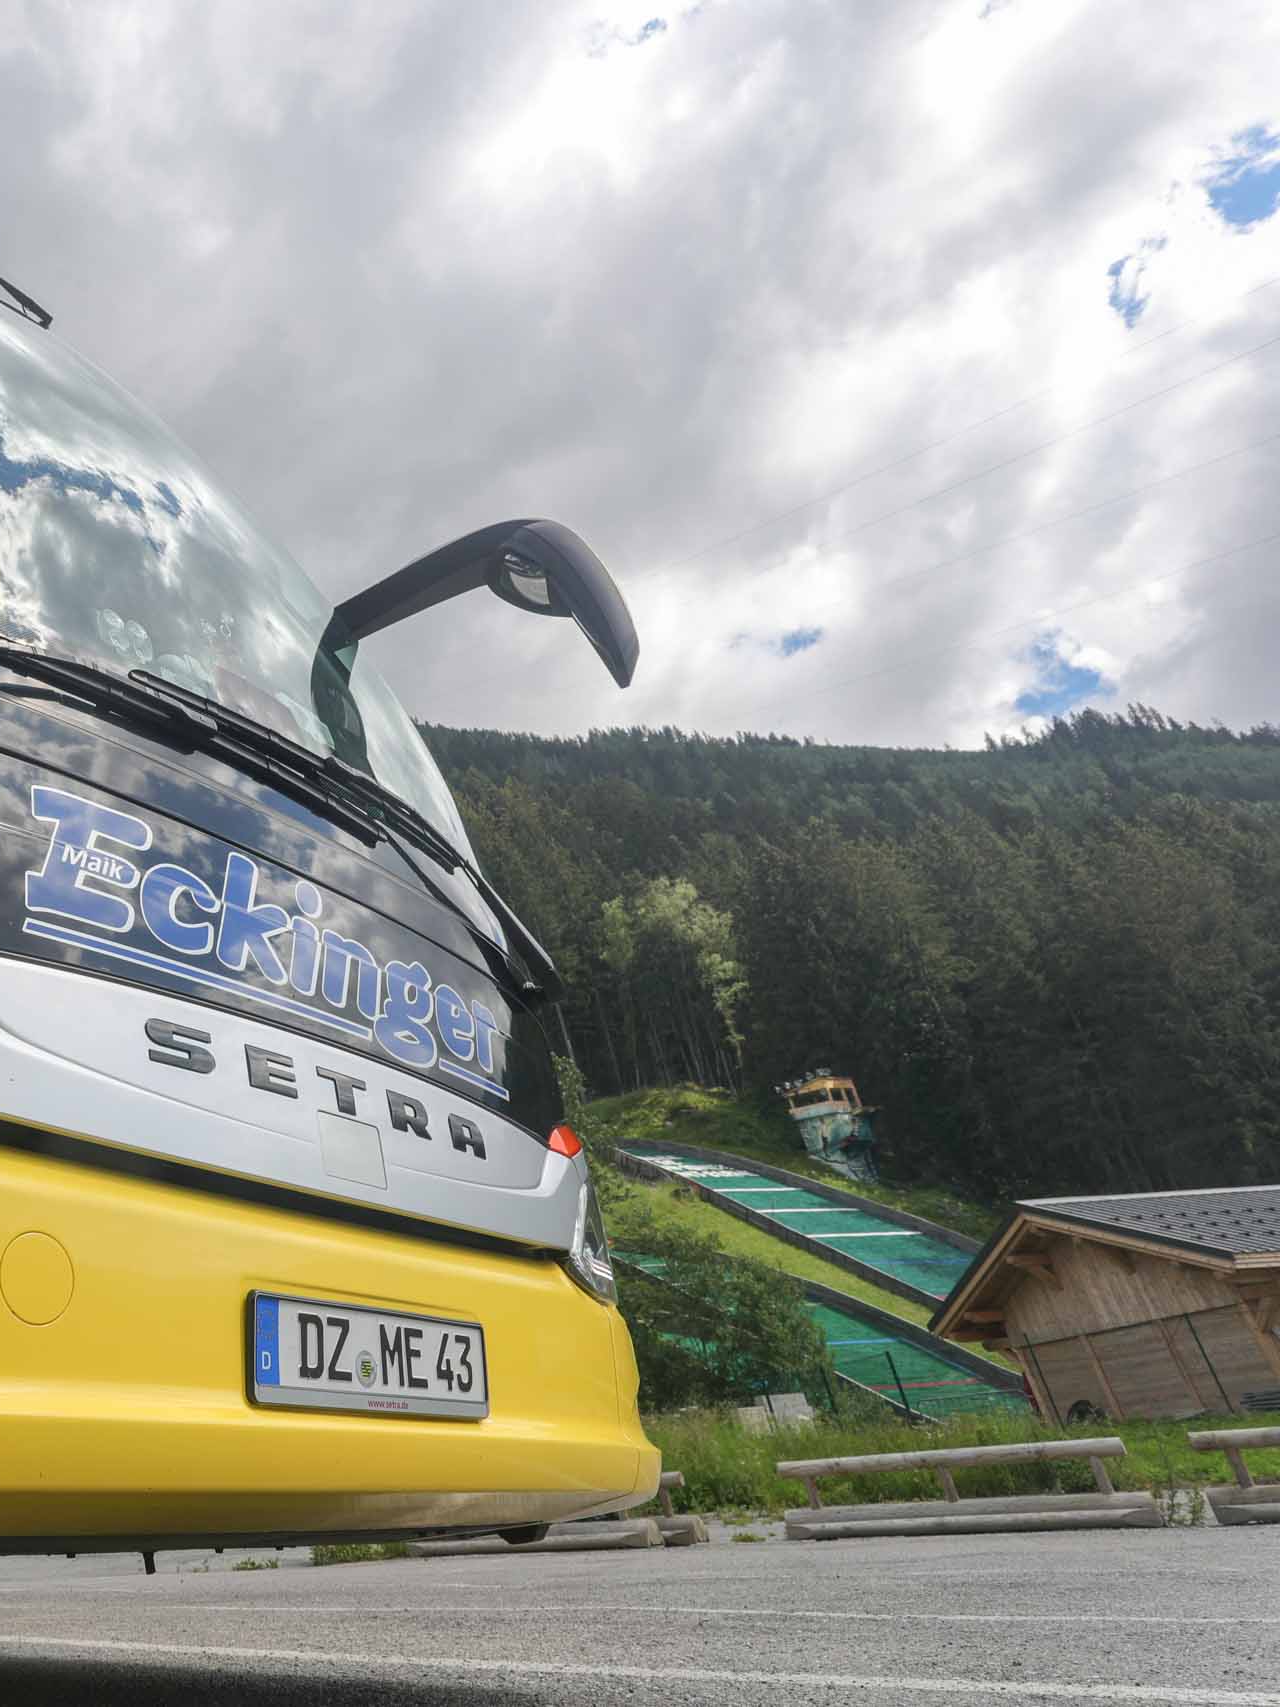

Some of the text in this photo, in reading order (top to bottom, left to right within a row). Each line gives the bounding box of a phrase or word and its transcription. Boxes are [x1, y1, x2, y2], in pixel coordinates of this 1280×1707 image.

[61, 843, 124, 881] Maik
[25, 784, 498, 1073] Eckinger
[145, 1017, 487, 1161] SETRA
[261, 1351, 271, 1370] D
[297, 1312, 473, 1393] DZ ME 43
[367, 1399, 409, 1410] www.setra.de
